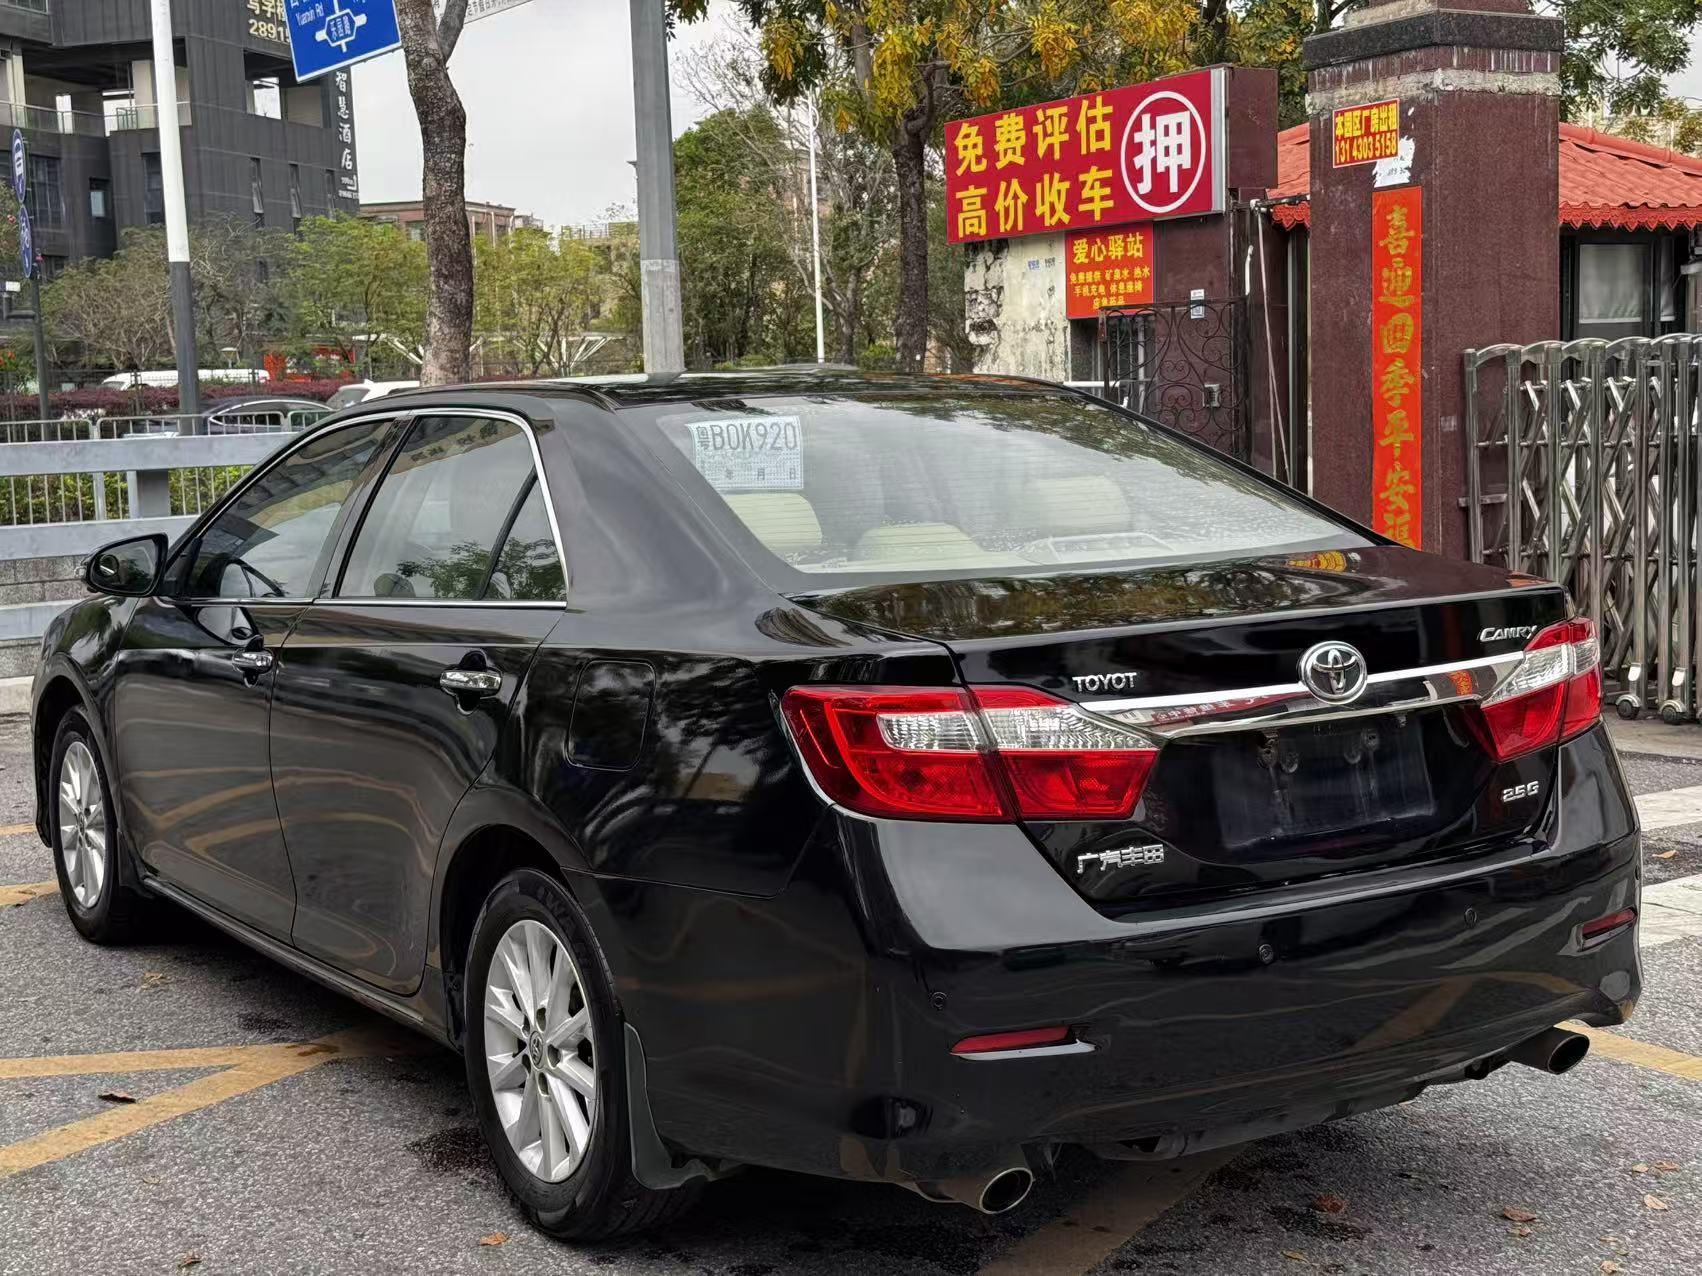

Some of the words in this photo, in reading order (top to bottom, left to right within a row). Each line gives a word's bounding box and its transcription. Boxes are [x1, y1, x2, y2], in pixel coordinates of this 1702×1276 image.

[336, 71, 353, 170] 智慧酒店
[954, 95, 1113, 177] 免费评估
[1133, 110, 1192, 195] 押
[1335, 138, 1350, 164] 131
[1352, 135, 1374, 161] 4303
[1375, 131, 1397, 157] 5158
[955, 166, 1114, 239] 高价收车
[1073, 232, 1144, 264] 爱心驿站
[1072, 672, 1137, 692] TOYOT
[1077, 843, 1165, 874] 广汽丰田
